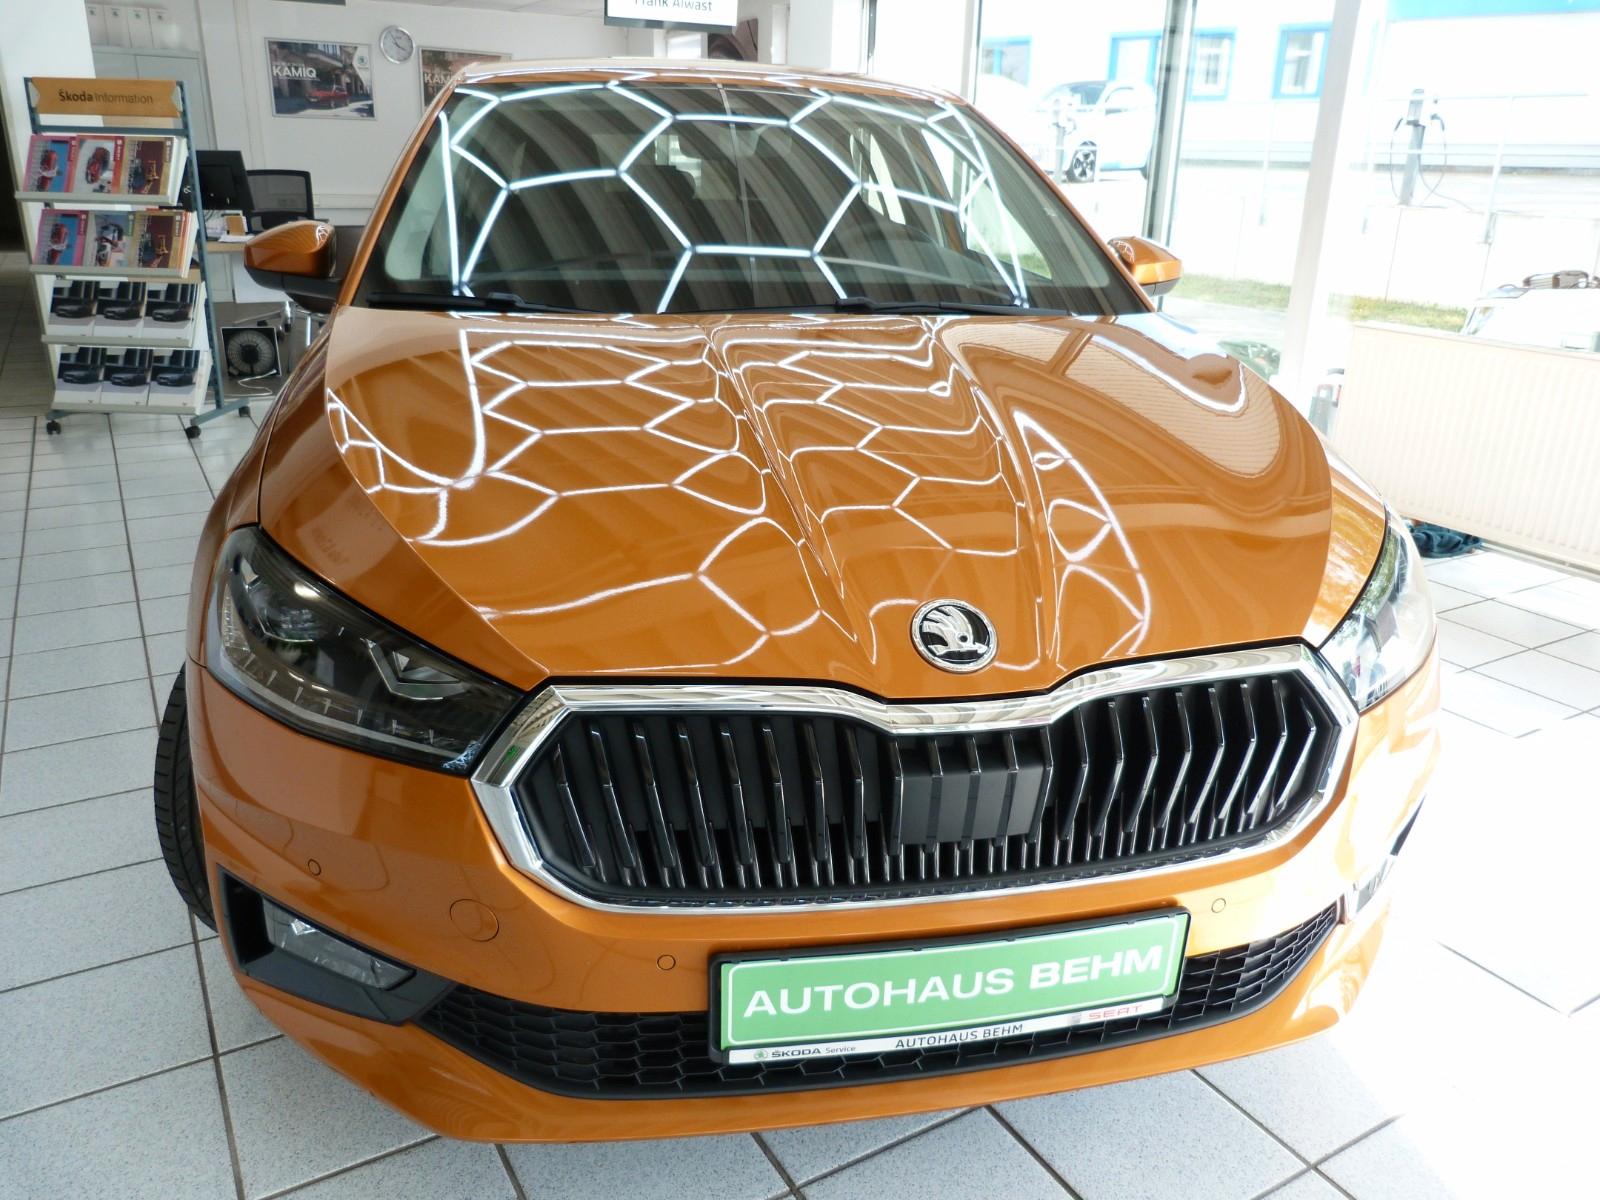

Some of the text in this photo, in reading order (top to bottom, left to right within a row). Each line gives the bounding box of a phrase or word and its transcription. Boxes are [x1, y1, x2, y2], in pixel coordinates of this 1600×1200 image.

[272, 65, 317, 78] KAMIQ
[58, 88, 94, 102] Škoda
[743, 944, 1163, 1018] AUTOHAUS BEHM
[1088, 1005, 1143, 1020] SEAT
[895, 1023, 1023, 1049] AUTOHAUS BEHM
[771, 1045, 857, 1058] ŠKODA Service
